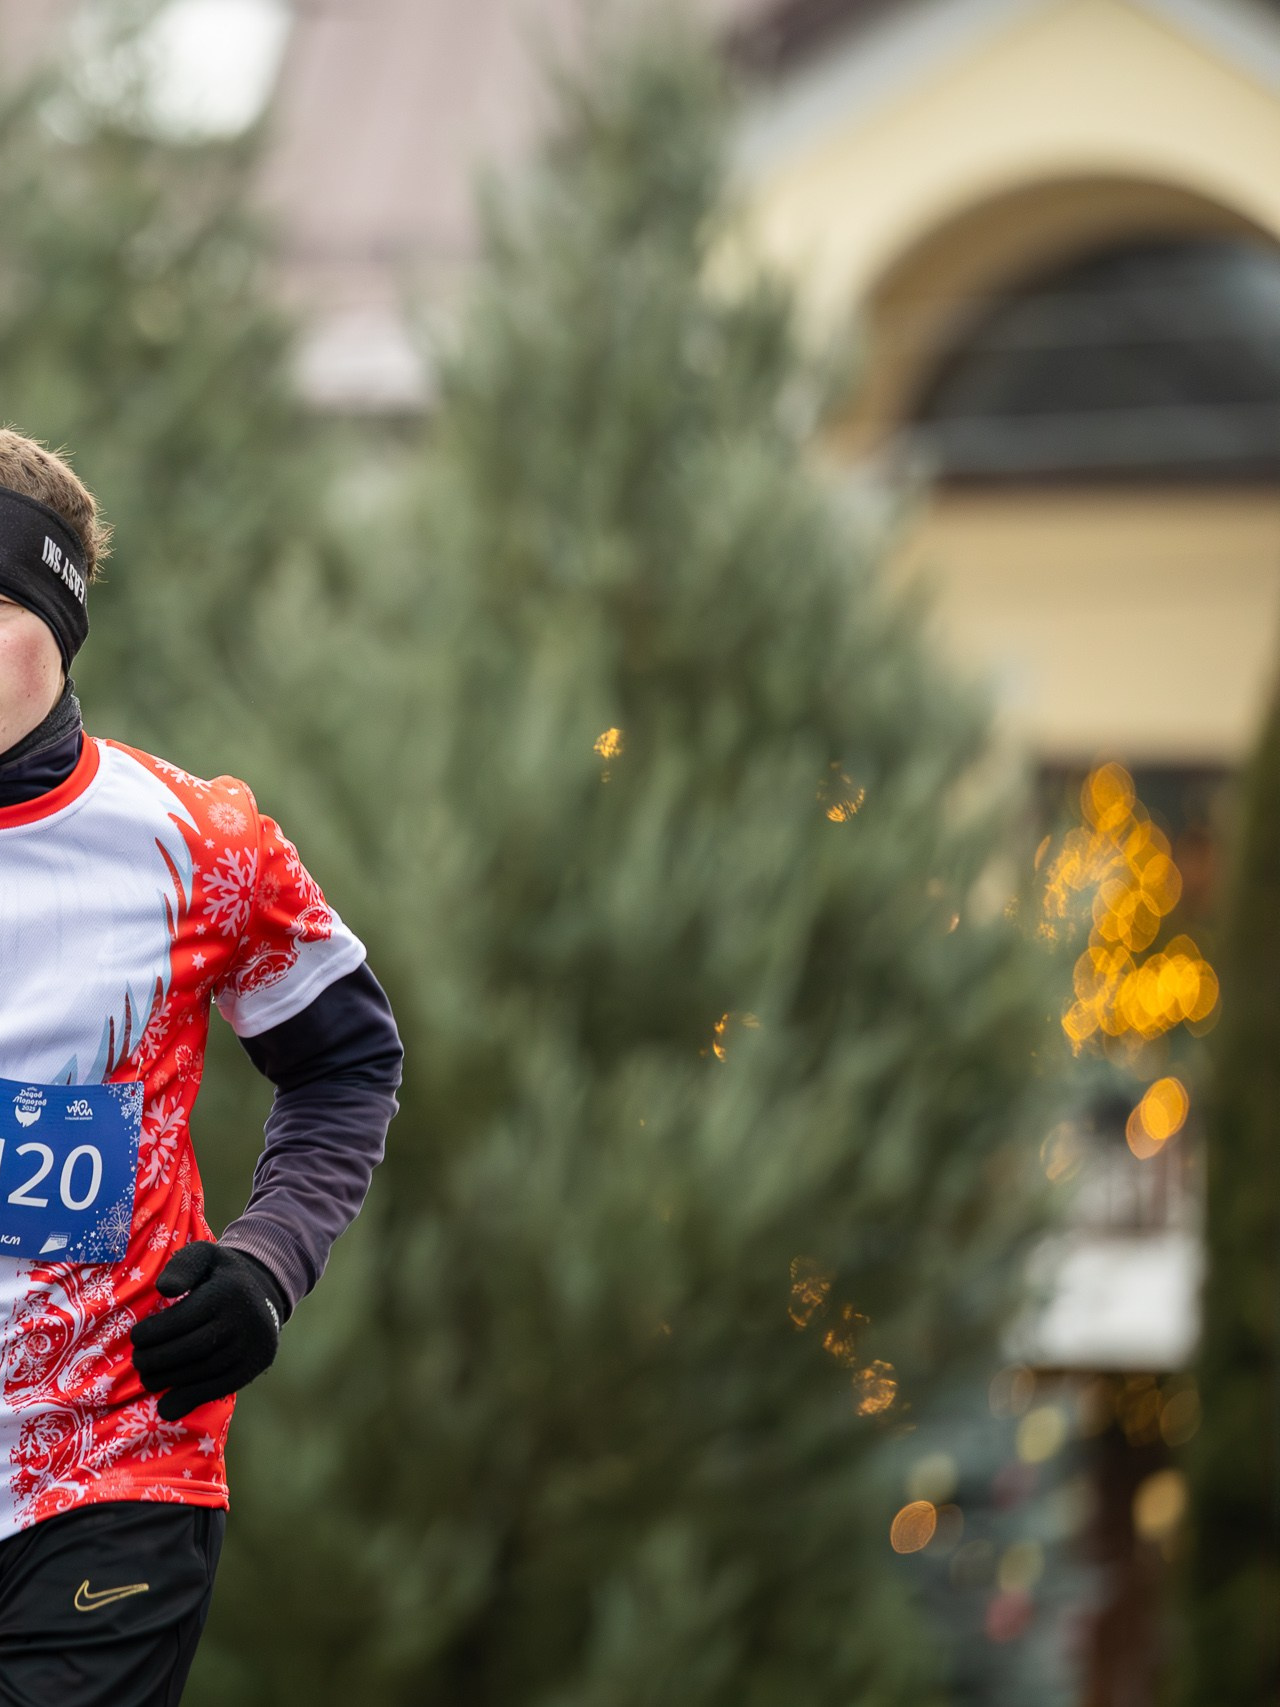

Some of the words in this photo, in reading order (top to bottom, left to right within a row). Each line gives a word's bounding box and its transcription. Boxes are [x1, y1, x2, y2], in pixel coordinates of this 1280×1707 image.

[41, 535, 62, 573] SKI
[60, 557, 84, 604] EASY
[0, 1234, 22, 1246] км
